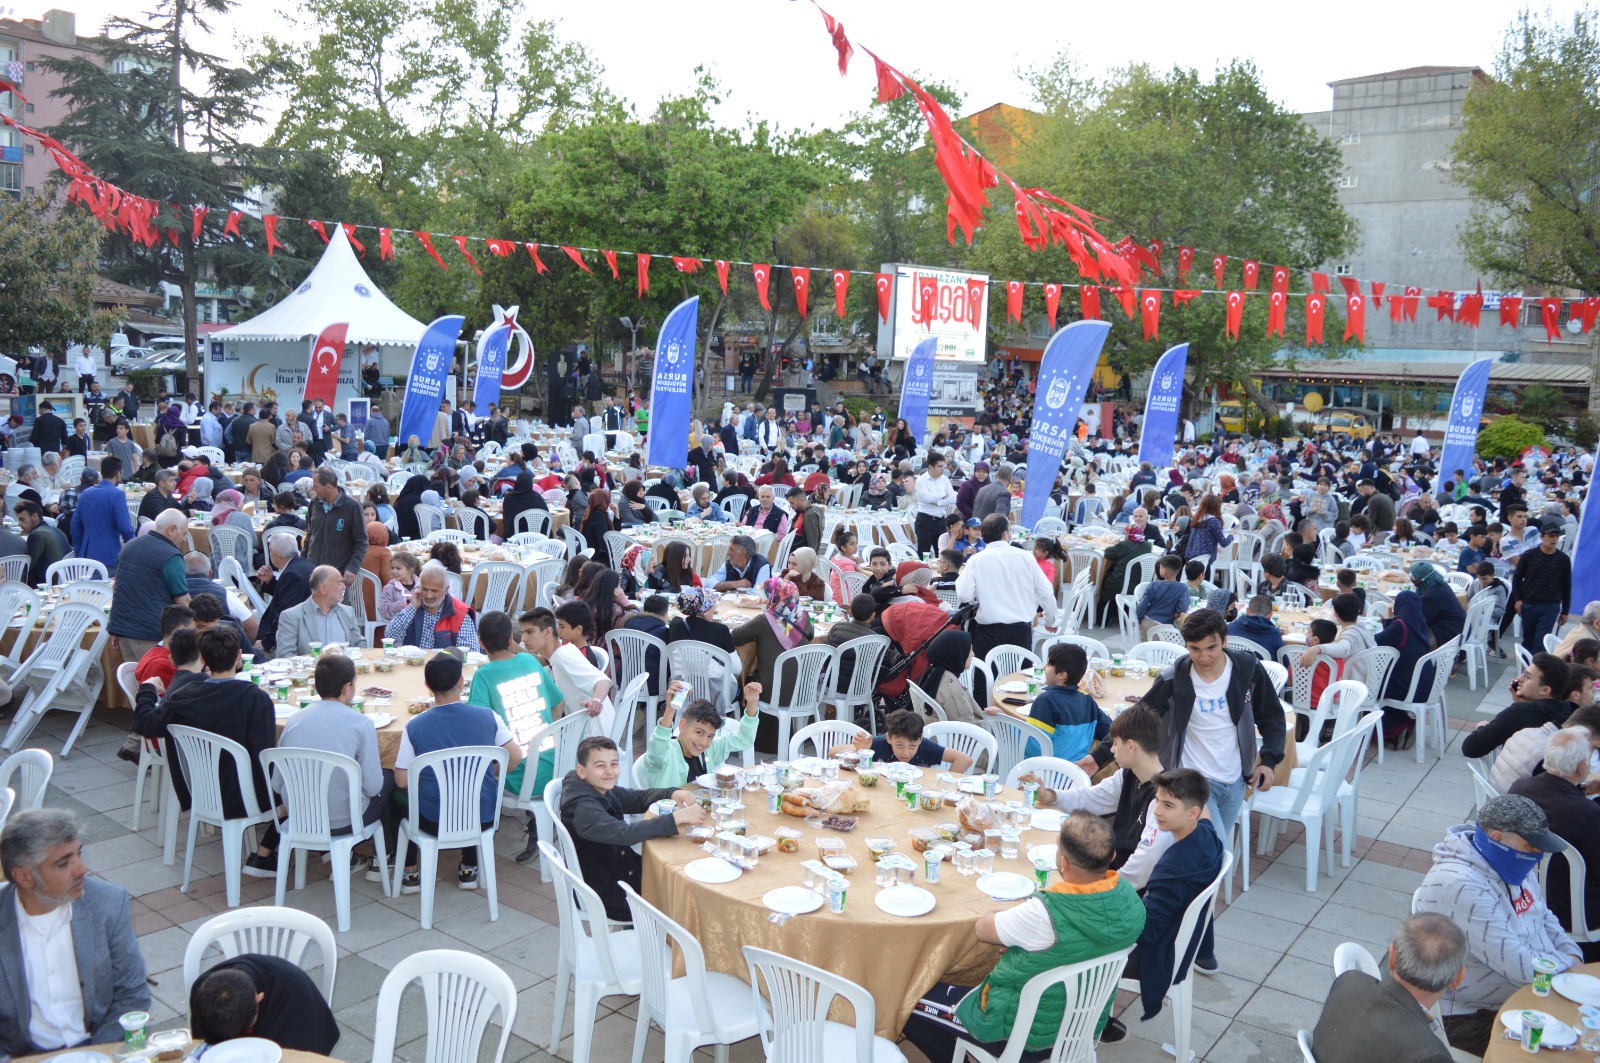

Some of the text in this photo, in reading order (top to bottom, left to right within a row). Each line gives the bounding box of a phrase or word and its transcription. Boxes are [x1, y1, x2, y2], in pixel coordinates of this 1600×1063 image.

[275, 373, 294, 384] İftar
[413, 374, 441, 387] BURSA
[1032, 419, 1067, 440] URSA
[1449, 425, 1477, 435] BURSA
[1031, 430, 1065, 449] ÜKŞEHİR
[1030, 441, 1063, 458] EDİYESİ
[924, 1005, 939, 1016] NIKE
